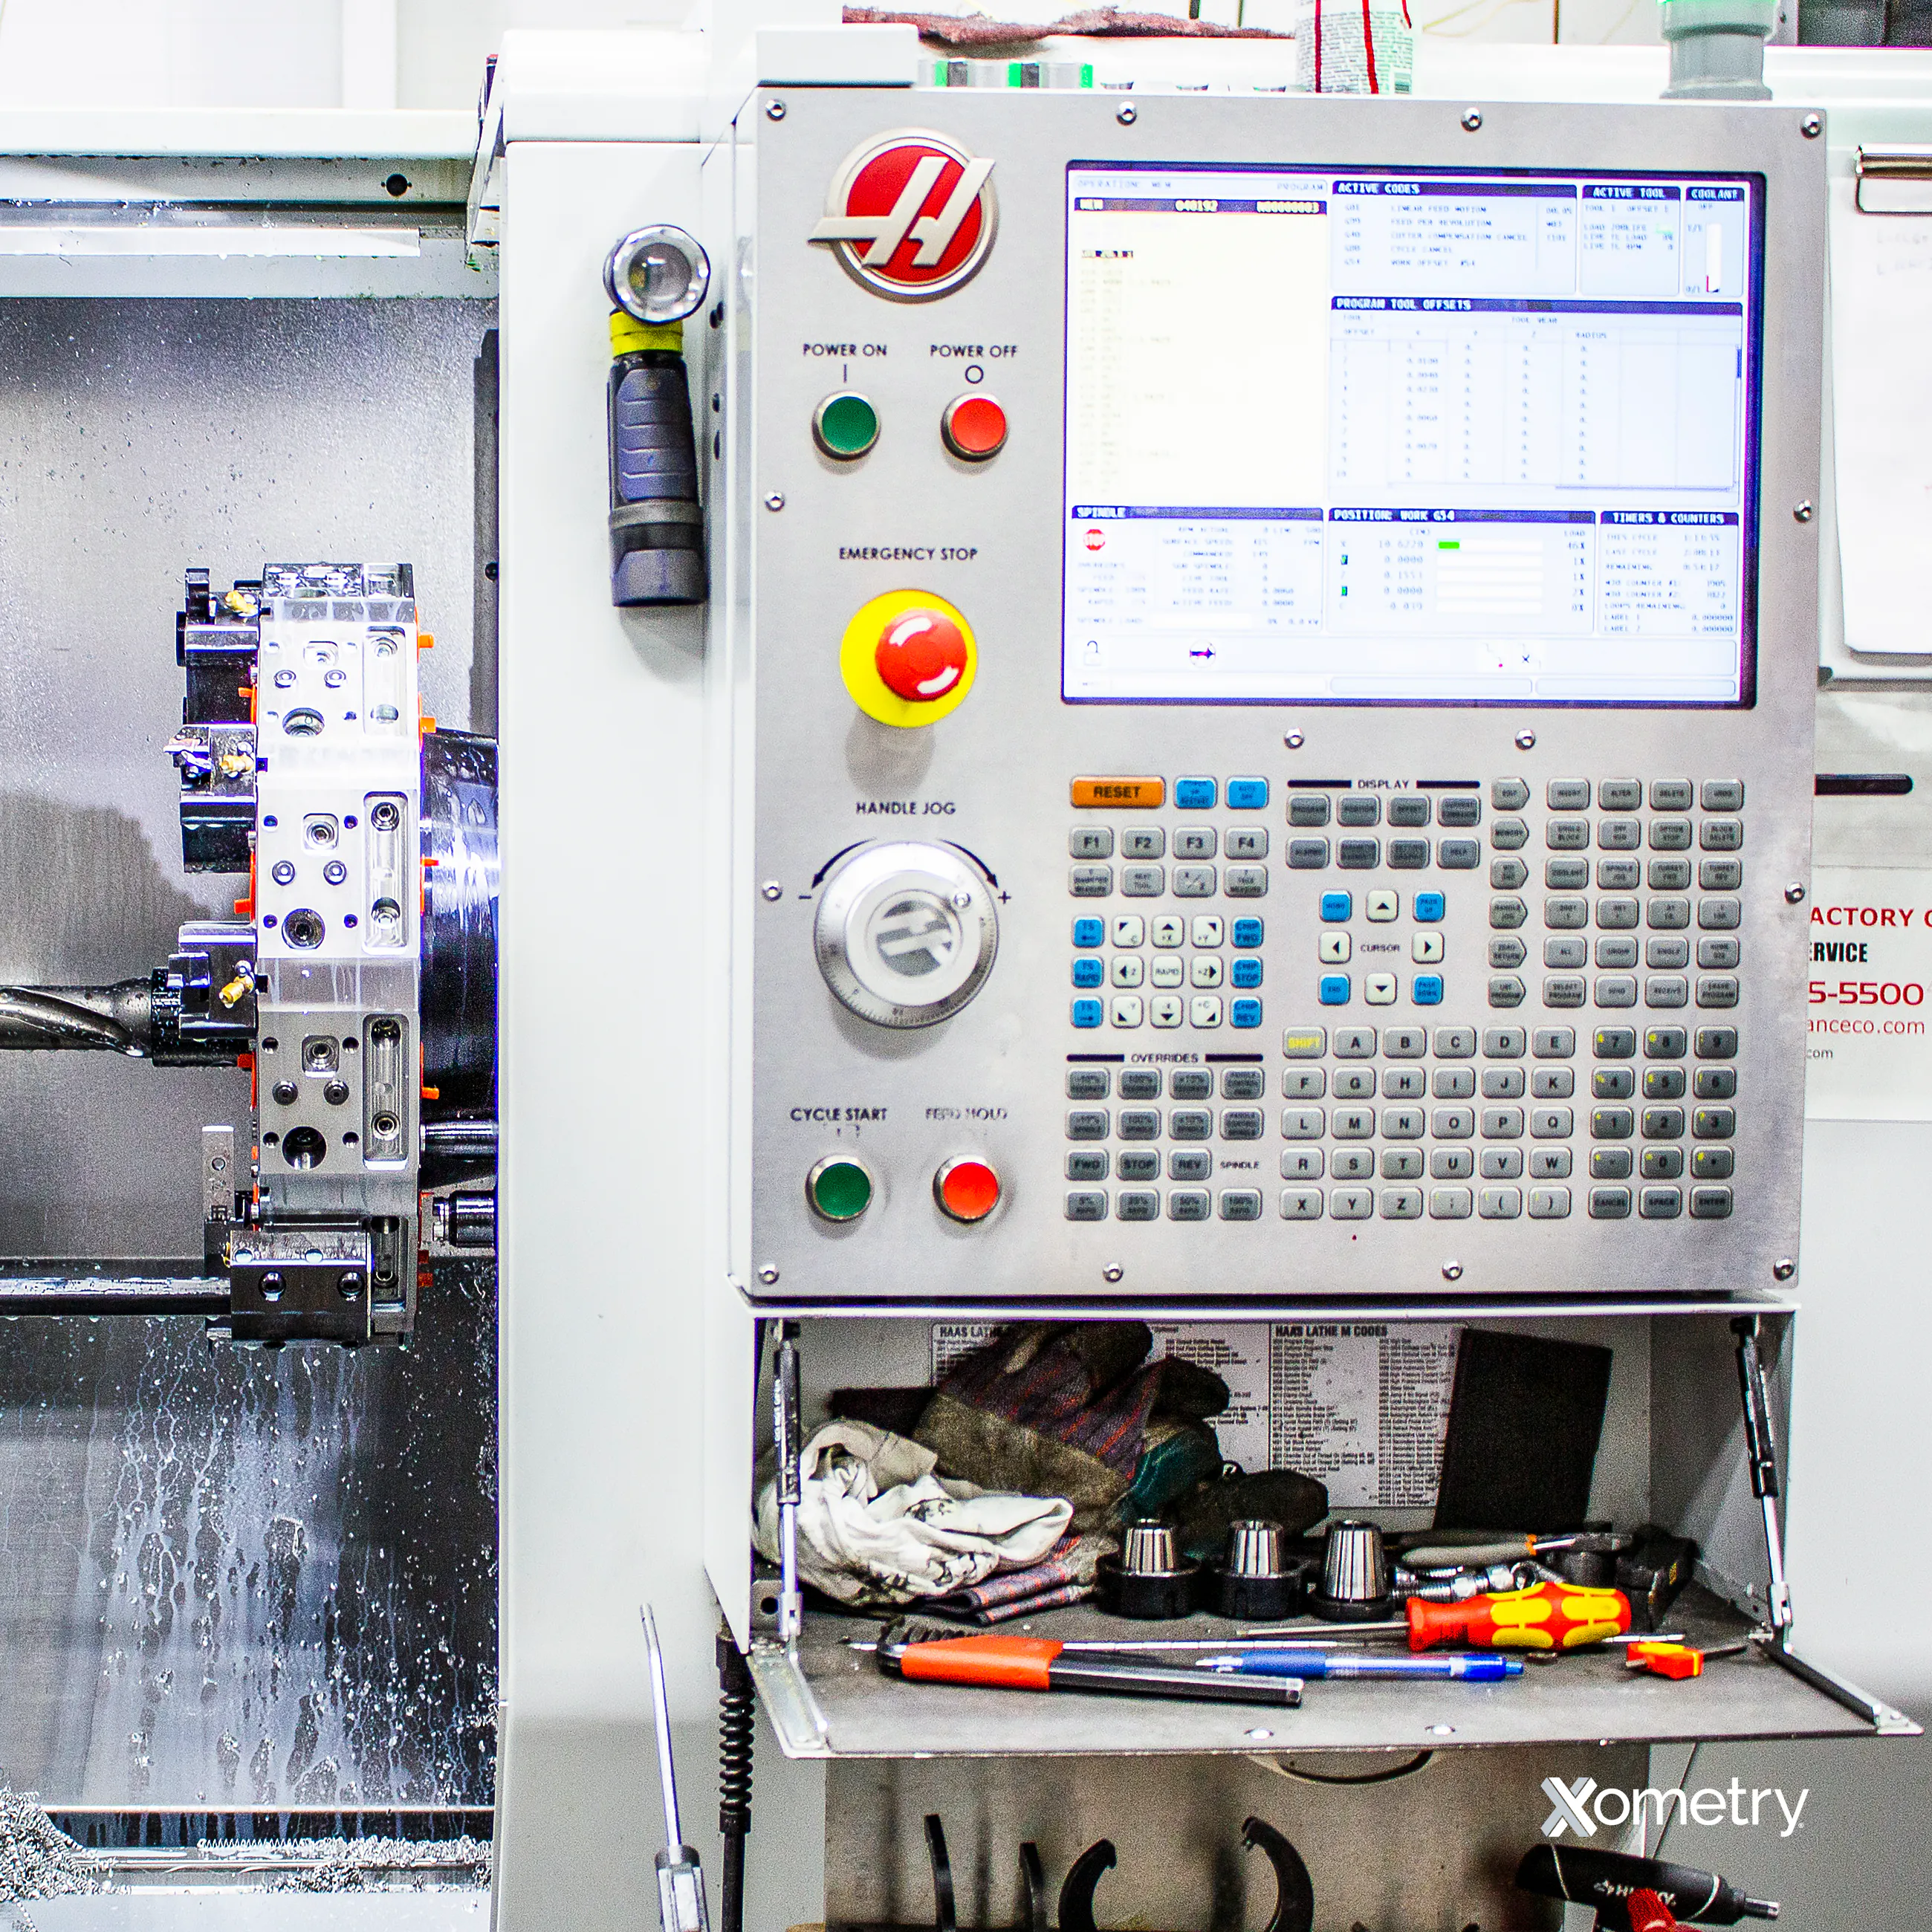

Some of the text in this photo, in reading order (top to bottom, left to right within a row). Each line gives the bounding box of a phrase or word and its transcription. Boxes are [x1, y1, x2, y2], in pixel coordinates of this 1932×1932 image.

[1338, 183, 1420, 194] ACTIVE CODES
[1593, 187, 1664, 198] ACTIVE TOOL
[1691, 189, 1737, 200] COOLANT
[1337, 299, 1471, 311] PROGRAM TOOL OFFSETS
[803, 343, 887, 357] POWER ON
[930, 344, 1018, 357] POWER OFF
[1400, 510, 1428, 521] WORK
[1612, 513, 1653, 524] TIMERS
[1670, 513, 1725, 524] COUNTERS
[839, 546, 979, 560] EMERGENCY STOP
[1358, 779, 1410, 790] DISPLAY
[1093, 785, 1141, 799] RESET
[856, 801, 956, 815] HANDLE JOG
[1083, 836, 1100, 849] F1
[1135, 836, 1152, 849] F2
[1186, 837, 1204, 849] F3
[1238, 837, 1255, 849] F4
[1810, 907, 1914, 927] ACTORY
[1360, 944, 1401, 953] CURSOR
[1809, 942, 1868, 962] RVICE
[1808, 981, 1924, 1005] 5-5500
[1288, 1037, 1320, 1049] SHIFT
[1349, 1037, 1361, 1048] A
[1400, 1037, 1410, 1048] B
[1450, 1037, 1460, 1048] C
[1500, 1037, 1510, 1048] D
[1550, 1037, 1560, 1048] E
[1612, 1035, 1619, 1048] 7
[1130, 1054, 1199, 1063] OVERRIDES
[1300, 1077, 1309, 1089] F
[1349, 1077, 1361, 1089] G
[1400, 1077, 1410, 1089] H
[1453, 1077, 1457, 1089] I
[1500, 1077, 1508, 1089] J
[1549, 1077, 1558, 1089] K
[1610, 1077, 1618, 1088] 4
[790, 1107, 888, 1121] CYCLE START
[1300, 1118, 1308, 1129] L
[1348, 1118, 1361, 1129] M
[1399, 1118, 1409, 1129] N
[1448, 1118, 1459, 1129] O
[1498, 1118, 1508, 1129] P
[1547, 1118, 1558, 1129] Q
[1074, 1160, 1100, 1169] FWD
[1124, 1160, 1153, 1169] STOP
[1178, 1160, 1202, 1169] REV
[1220, 1161, 1260, 1170] SPINDLE
[1298, 1158, 1309, 1170] R
[1349, 1158, 1358, 1170] S
[1398, 1158, 1408, 1170] T
[1448, 1158, 1458, 1170] U
[1497, 1158, 1508, 1170] V
[1545, 1158, 1559, 1170] W
[1659, 1155, 1667, 1168] 0
[1297, 1199, 1306, 1210] X
[1347, 1199, 1357, 1210] Y
[1397, 1199, 1407, 1210] Z
[940, 1326, 967, 1337] HAAS
[1275, 1326, 1388, 1337] HAAS LATHE M CODES
